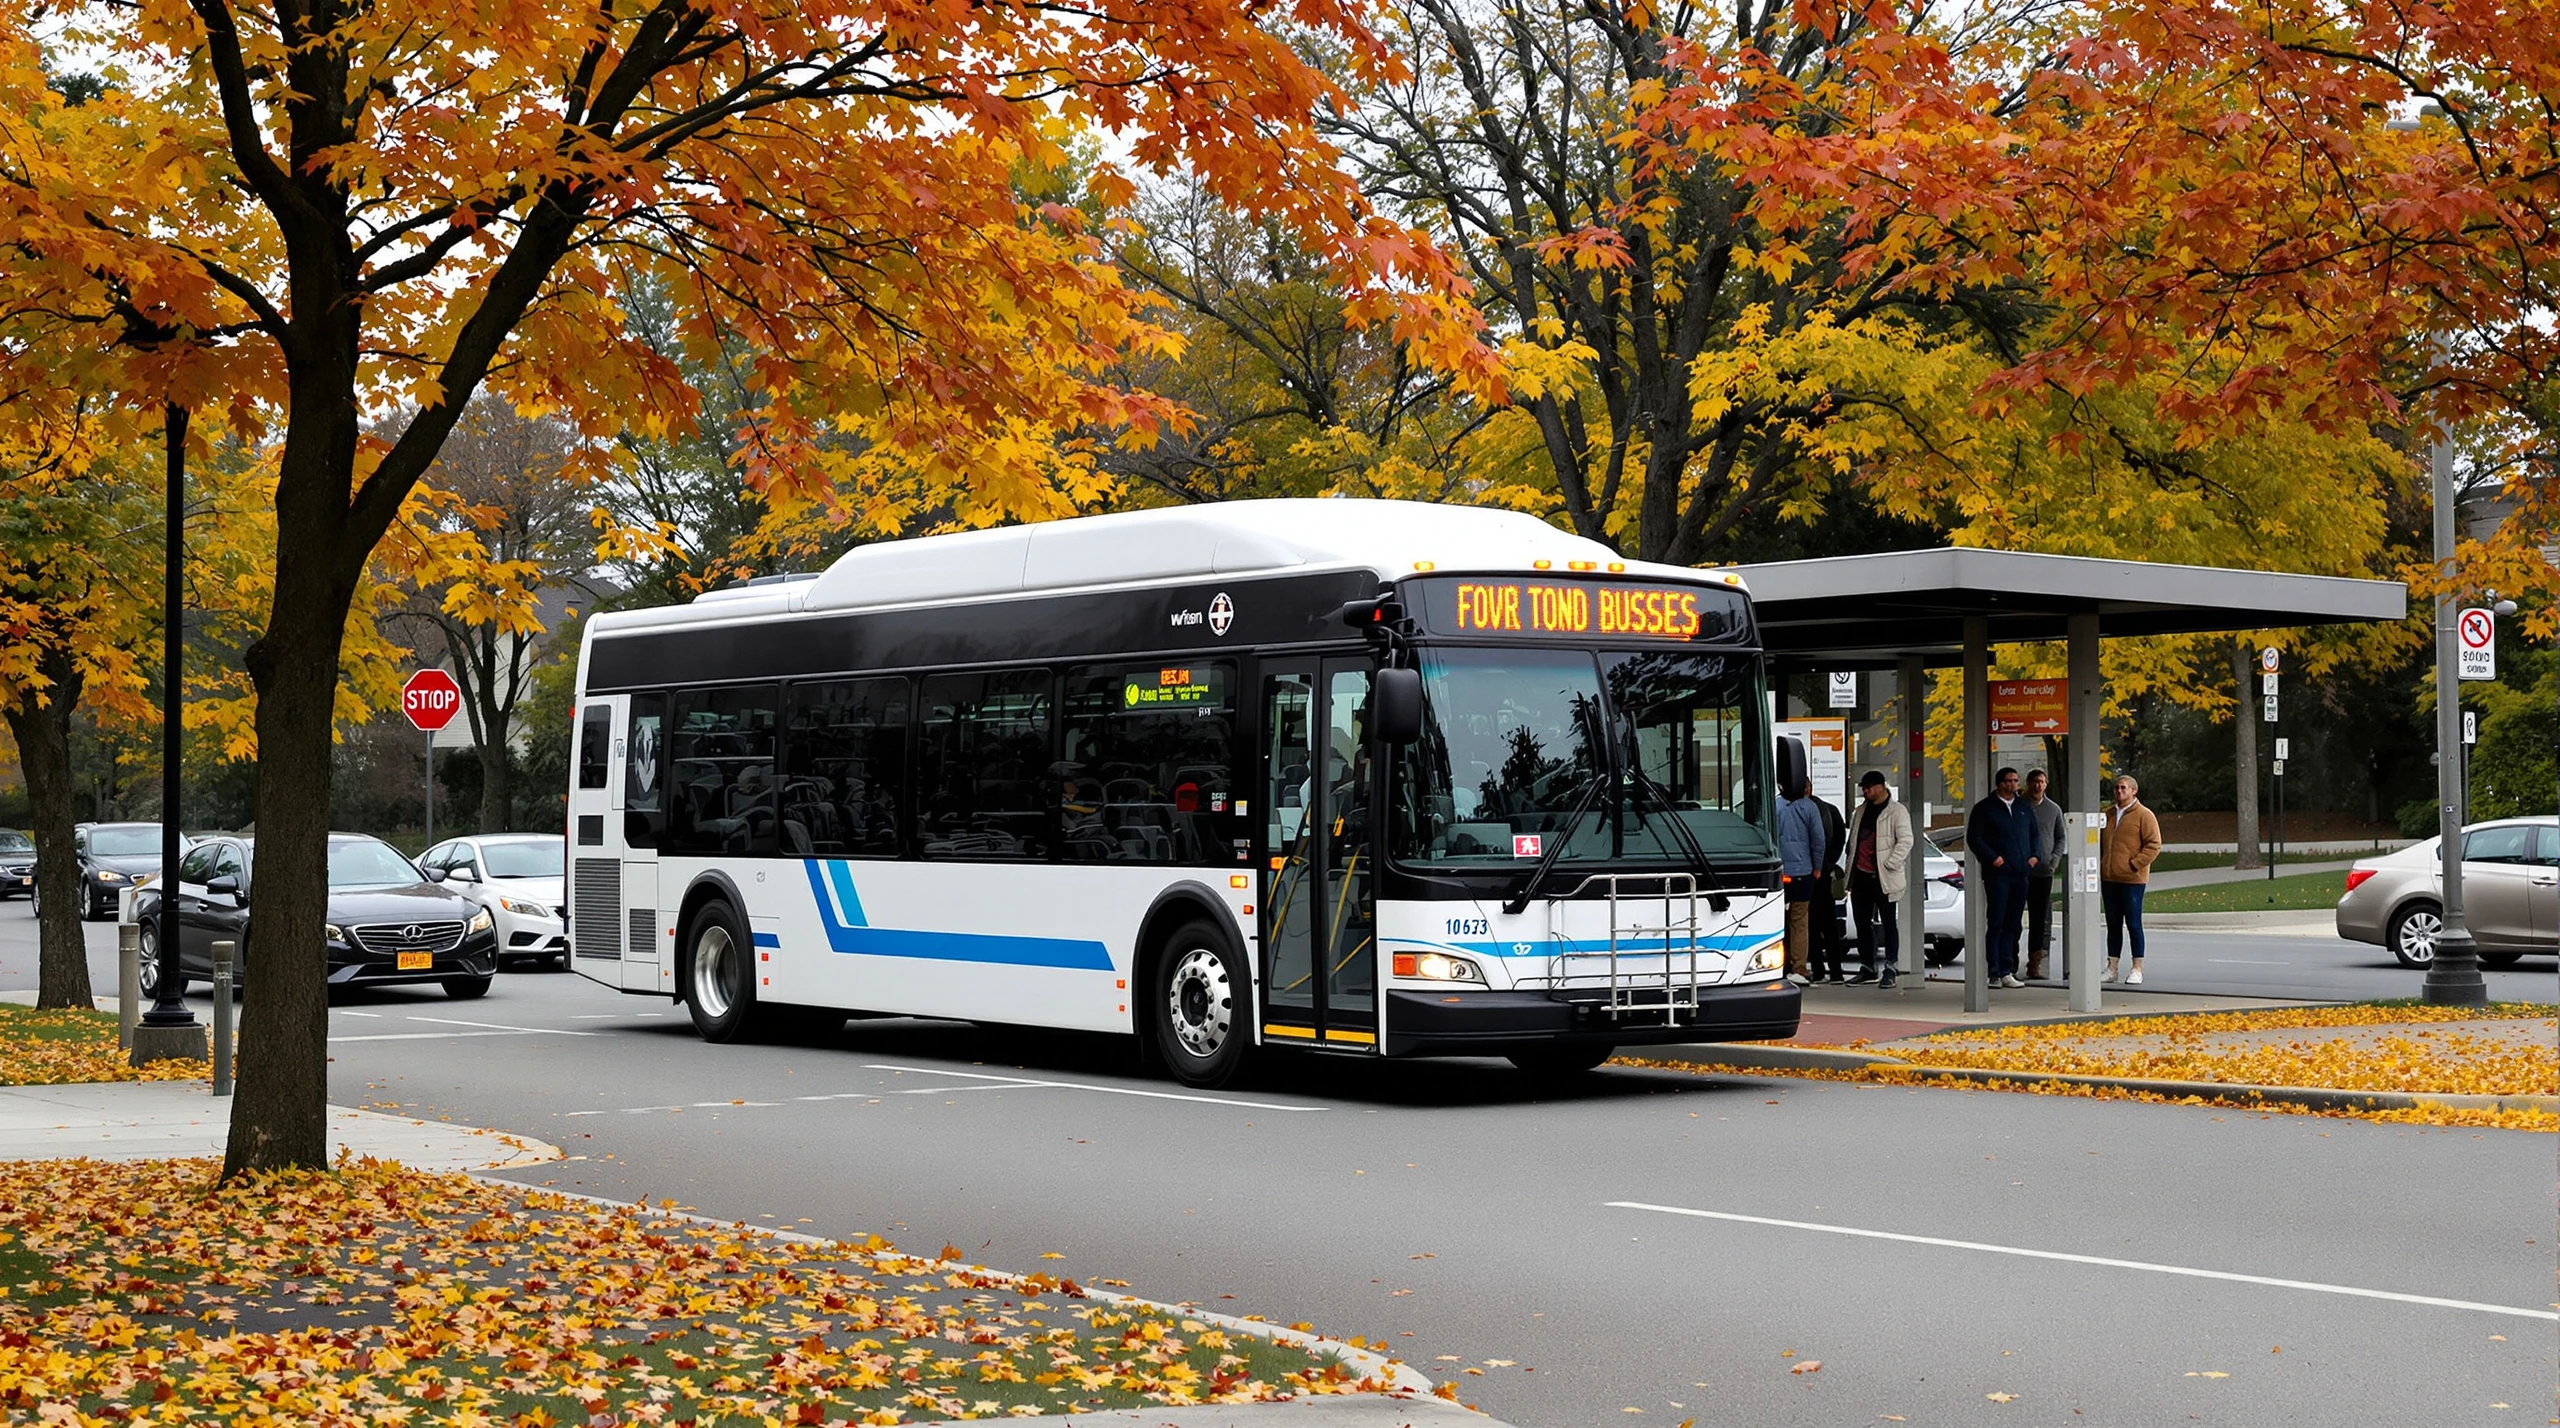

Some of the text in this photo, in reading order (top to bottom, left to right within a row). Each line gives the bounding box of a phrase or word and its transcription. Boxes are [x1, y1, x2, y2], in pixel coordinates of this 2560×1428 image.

[1527, 586, 1588, 632] TOND
[1599, 588, 1699, 635] BUSSES
[407, 689, 456, 710] STOP
